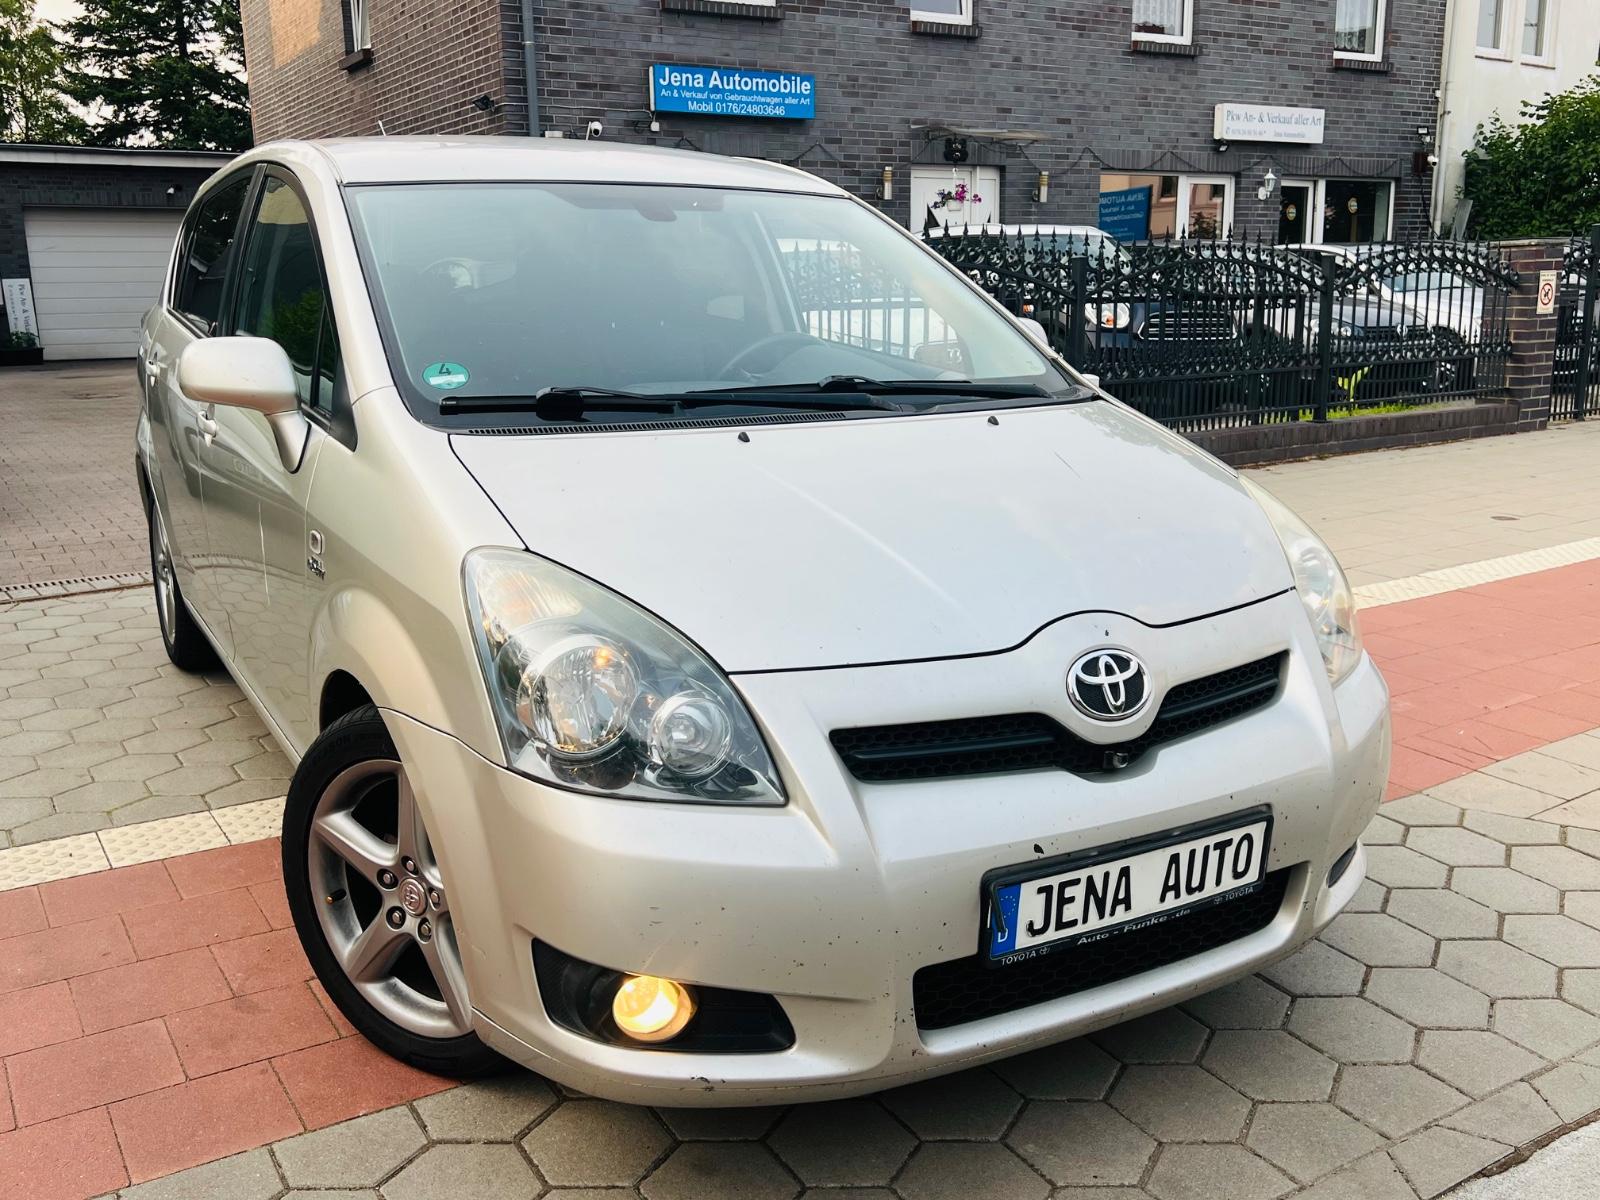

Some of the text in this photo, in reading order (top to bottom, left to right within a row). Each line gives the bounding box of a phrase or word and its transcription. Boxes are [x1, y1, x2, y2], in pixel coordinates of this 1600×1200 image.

[659, 67, 811, 94] Jena Automobile
[660, 88, 811, 105] An & Verkauf von Gebrauchtwagen aller Art
[688, 101, 786, 116] Mobil 0176/24803646
[1226, 110, 1322, 126] Pkw An- & Verkauf aller Art
[438, 363, 452, 375] 4
[1025, 832, 1254, 937] JENA AUTO
[1224, 886, 1255, 902] TOYOTA
[1077, 931, 1110, 946] Auto
[1123, 915, 1168, 933] Funke
[1001, 948, 1037, 966] TOYOTA
